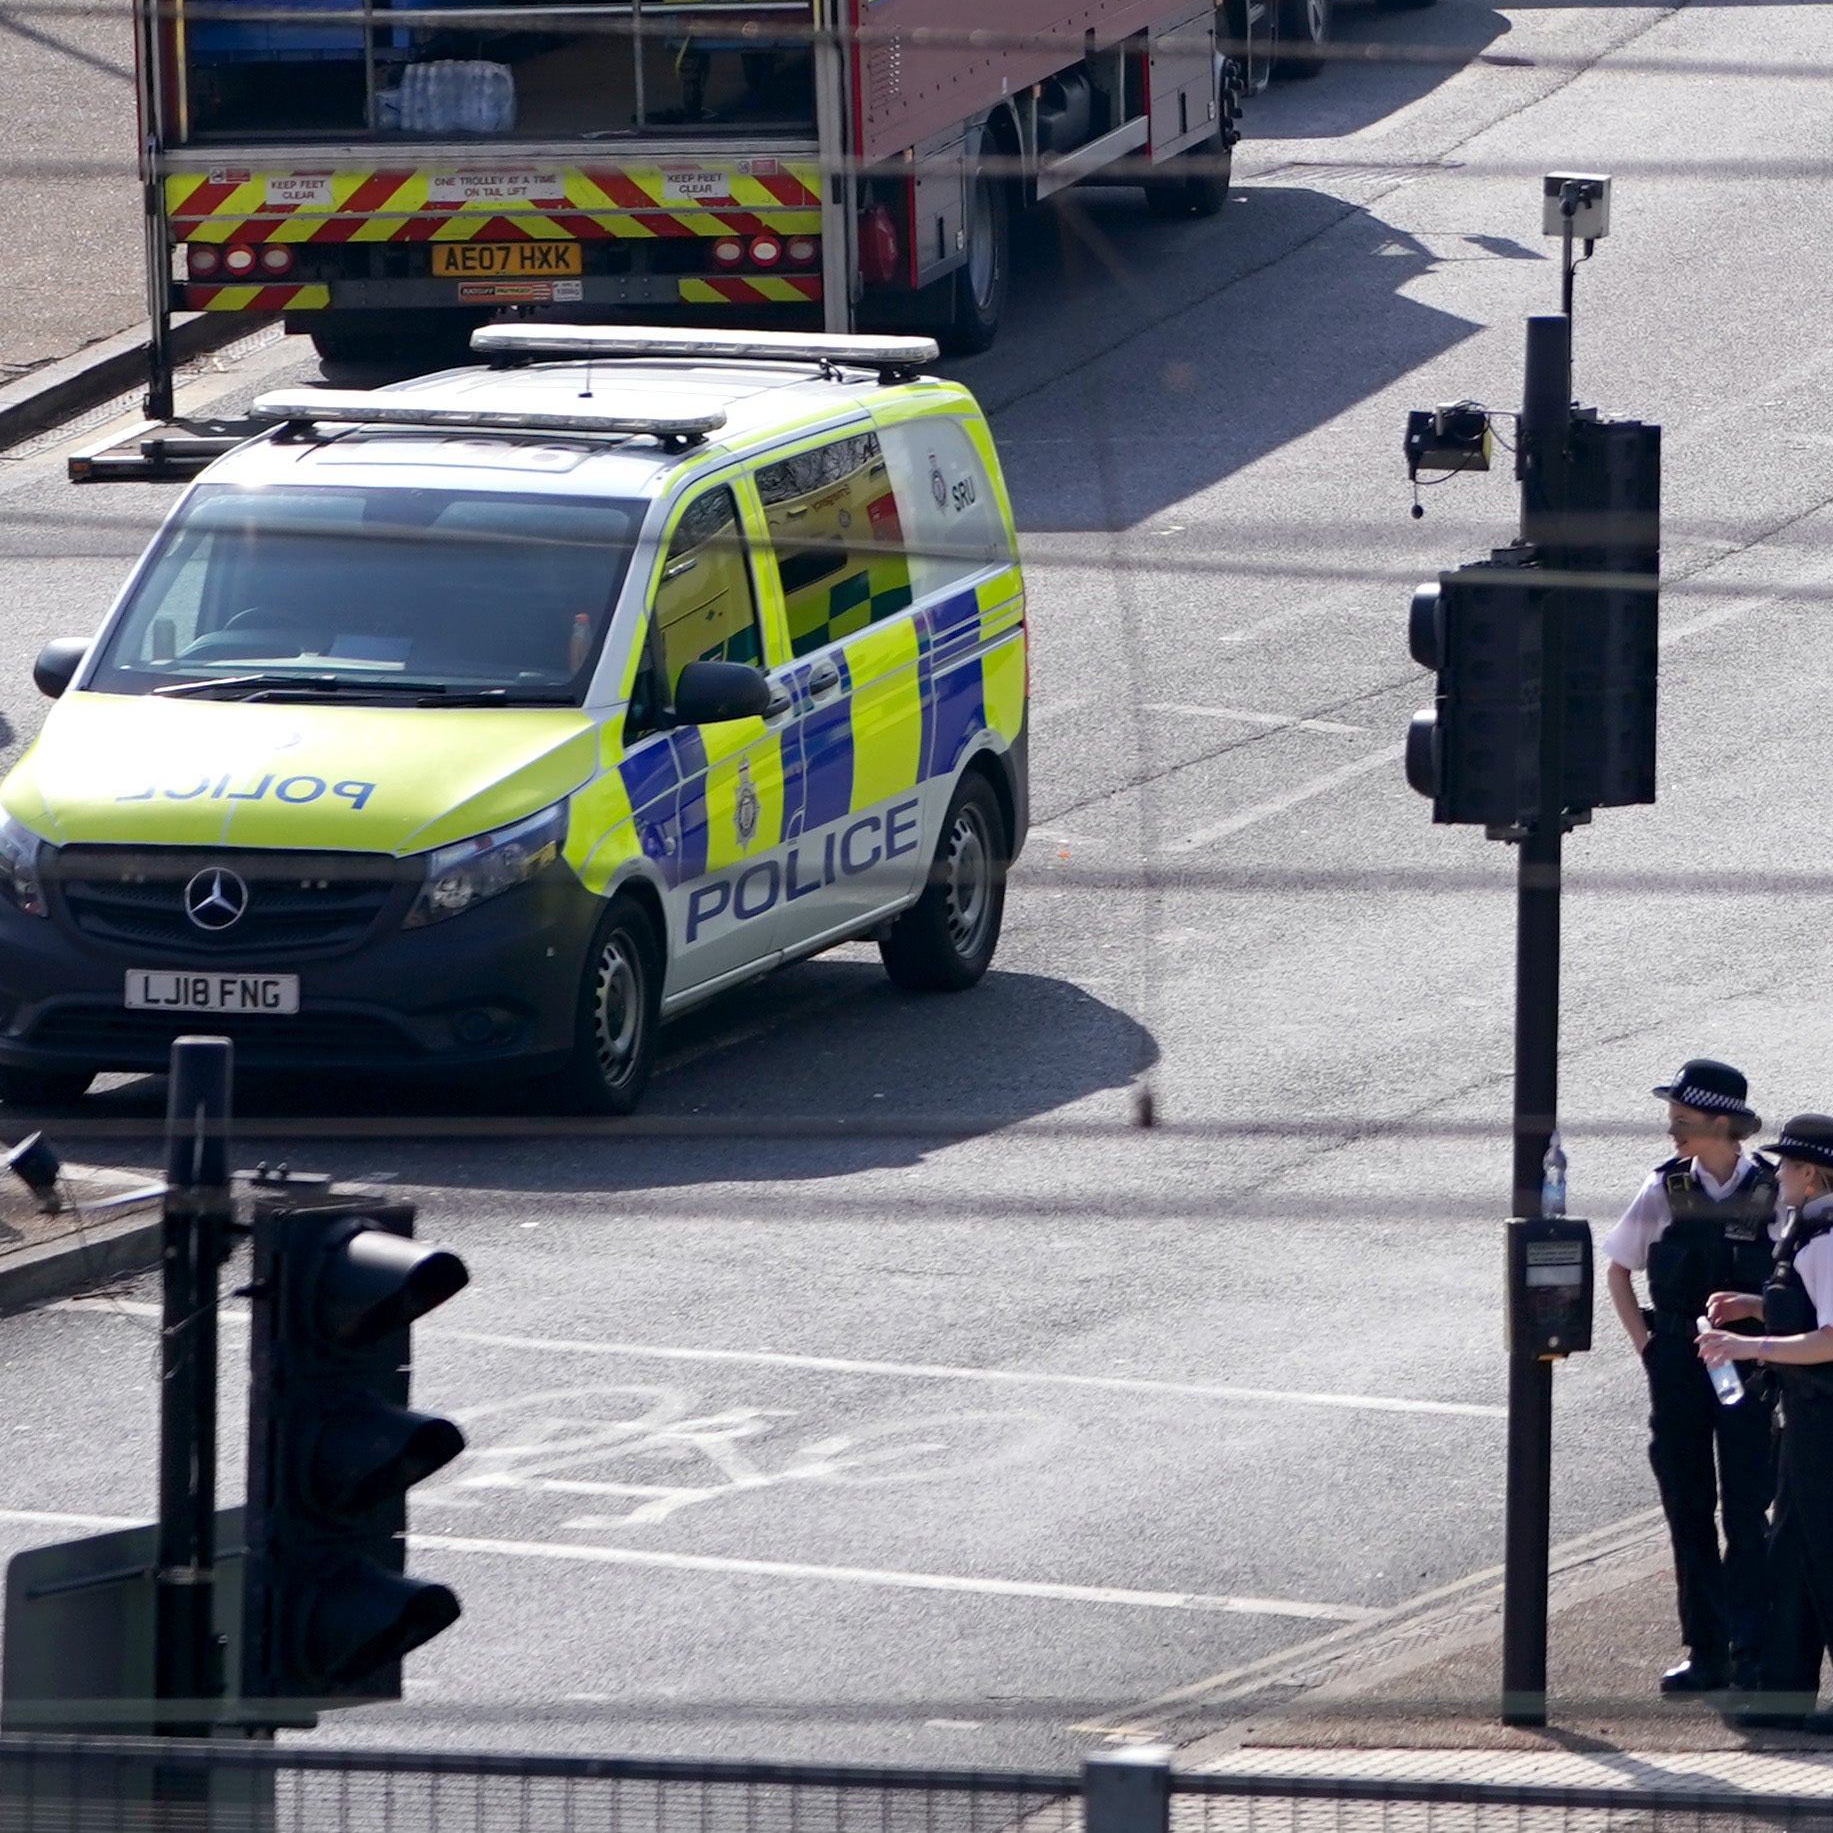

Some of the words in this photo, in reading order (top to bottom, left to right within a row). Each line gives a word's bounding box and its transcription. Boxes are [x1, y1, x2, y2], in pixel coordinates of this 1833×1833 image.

[434, 177, 455, 188] ONE
[459, 176, 503, 187] TROLLEY
[507, 175, 525, 186] AT
[528, 175, 537, 185] A
[539, 175, 558, 185] TIME
[667, 173, 694, 184] KEEP
[697, 172, 723, 183] FEET
[269, 179, 298, 192] KEEP
[300, 178, 325, 190] FEET
[679, 183, 713, 194] CLEAR
[282, 190, 315, 201] CLEAR
[465, 187, 481, 198] ON
[482, 187, 505, 197] TAIL
[506, 186, 528, 197] LIFT
[444, 247, 513, 271] AE07
[519, 246, 571, 270] HXK
[951, 475, 976, 513] SRU
[684, 797, 920, 944] POLICE
[142, 978, 210, 1010] LJ18
[216, 978, 284, 1011] FNG
